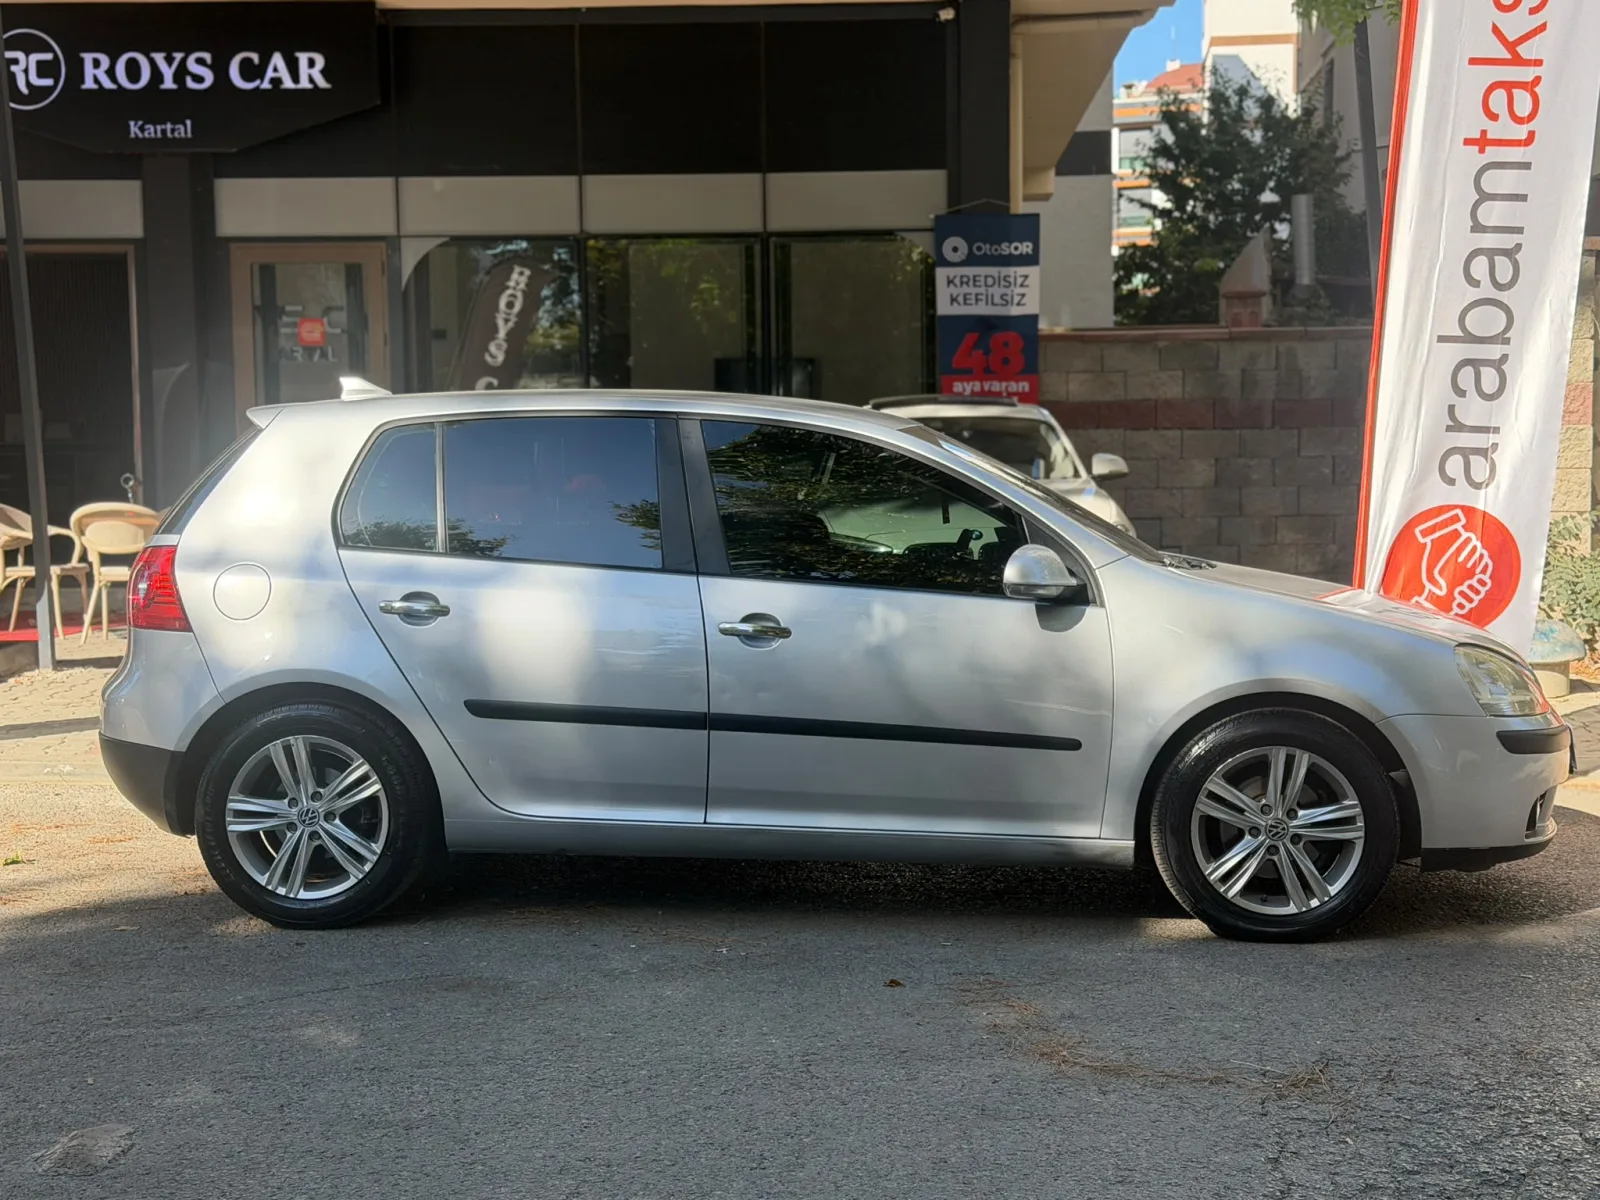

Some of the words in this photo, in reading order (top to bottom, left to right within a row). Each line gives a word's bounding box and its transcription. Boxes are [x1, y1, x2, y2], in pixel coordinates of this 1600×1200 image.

[79, 51, 215, 90] ROYS
[228, 51, 332, 90] CAR
[128, 119, 192, 138] Kartal
[972, 242, 1033, 256] OtoSOR
[484, 264, 531, 368] ROYS
[952, 330, 1025, 377] 48
